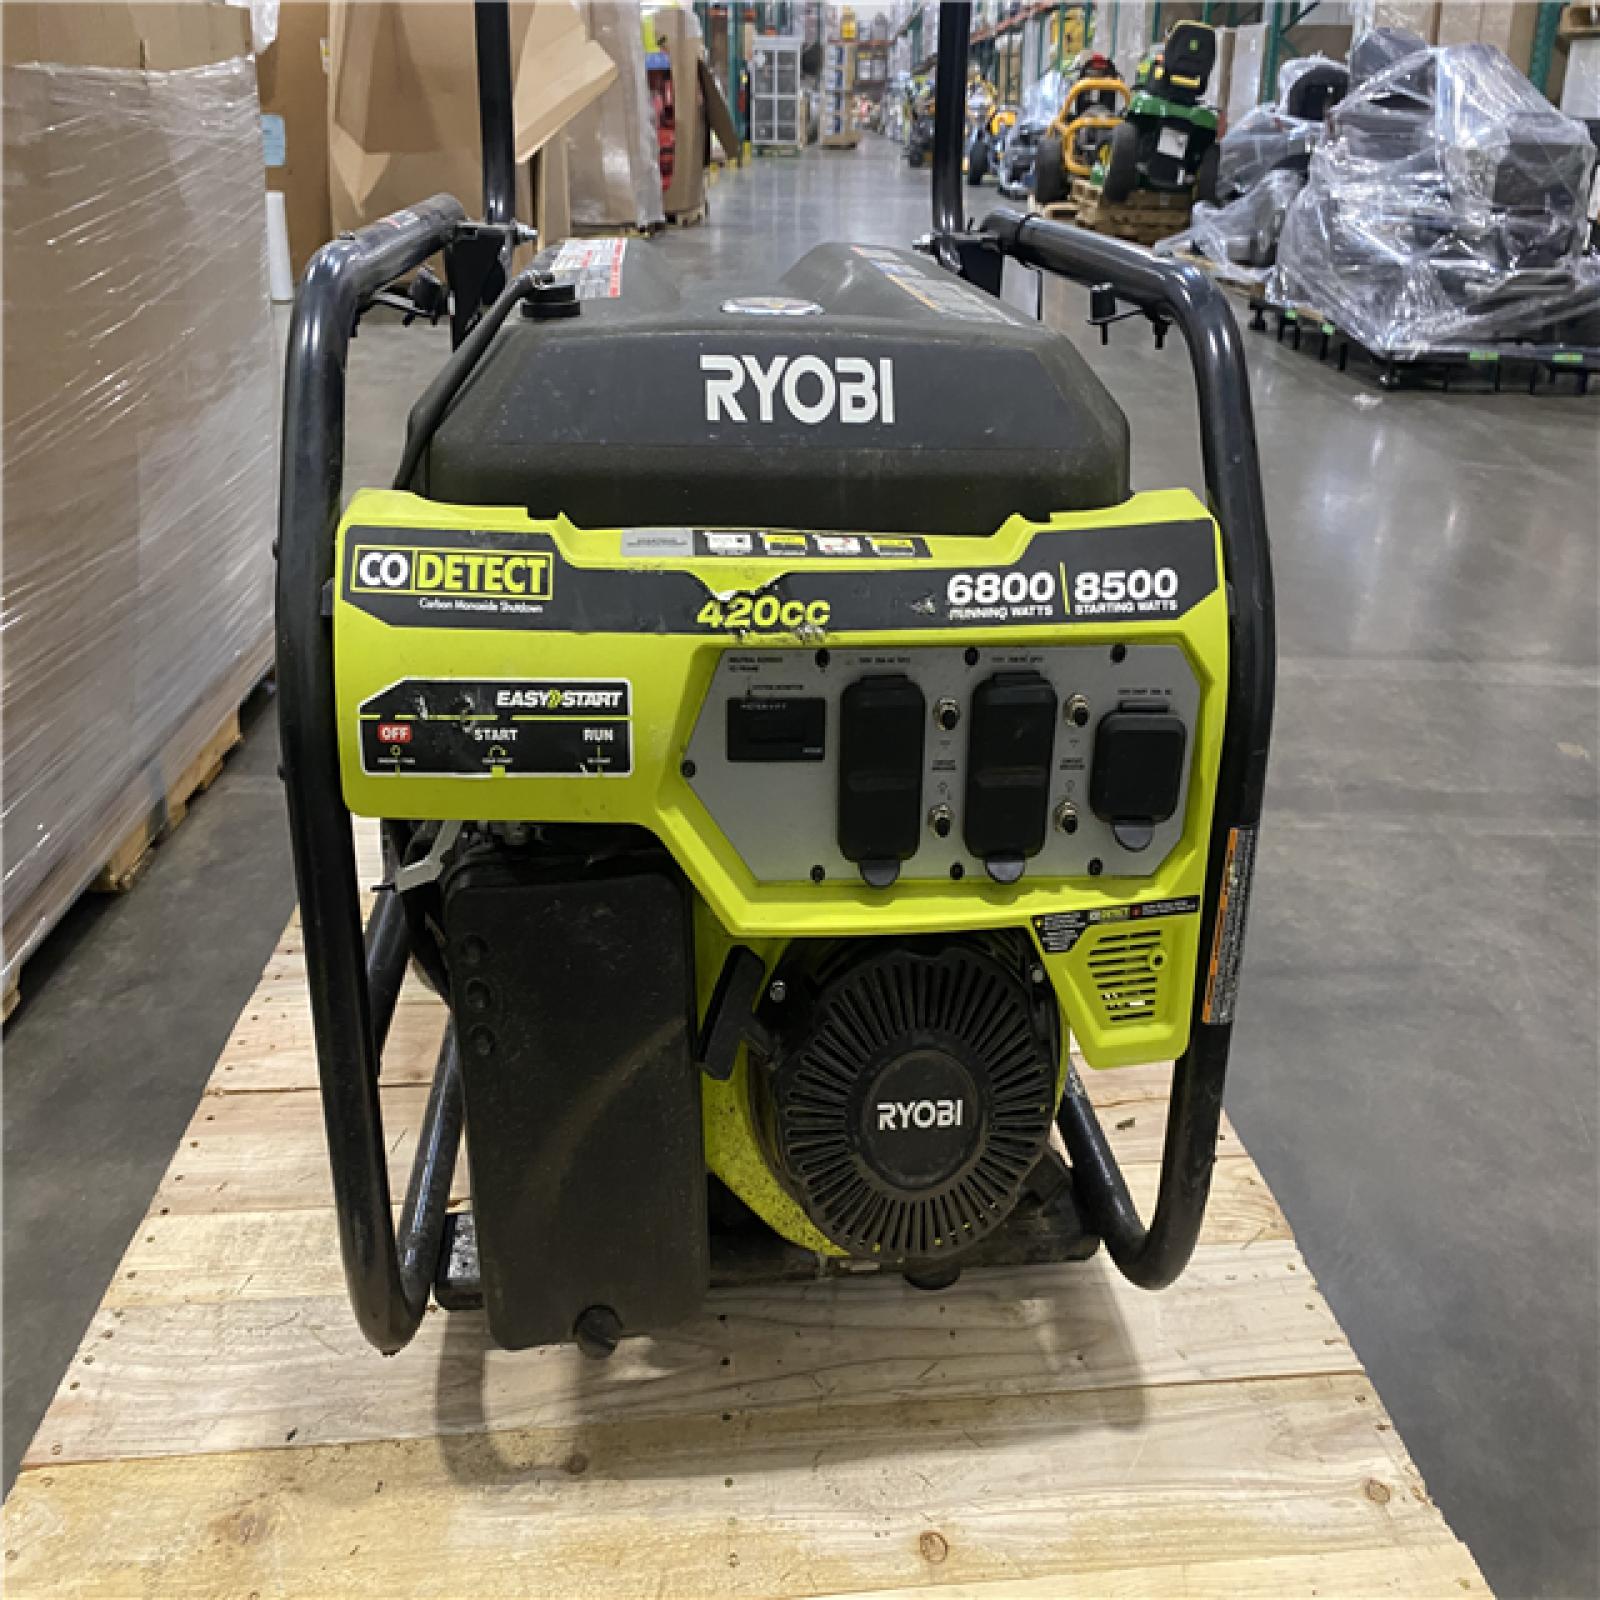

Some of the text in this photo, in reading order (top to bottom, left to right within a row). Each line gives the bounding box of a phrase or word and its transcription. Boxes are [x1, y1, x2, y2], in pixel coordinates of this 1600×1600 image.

[700, 354, 895, 424] RYOBI
[359, 552, 547, 593] CO DETECT
[947, 572, 1055, 605] 6800
[1074, 567, 1178, 602] 8500
[697, 595, 831, 628] 420cc
[1074, 602, 1134, 615] STARTING
[496, 690, 623, 707] EASY START
[381, 727, 409, 740] OFF
[474, 728, 518, 741] START
[583, 728, 613, 741] RUN
[877, 1099, 963, 1131] RYOBI
